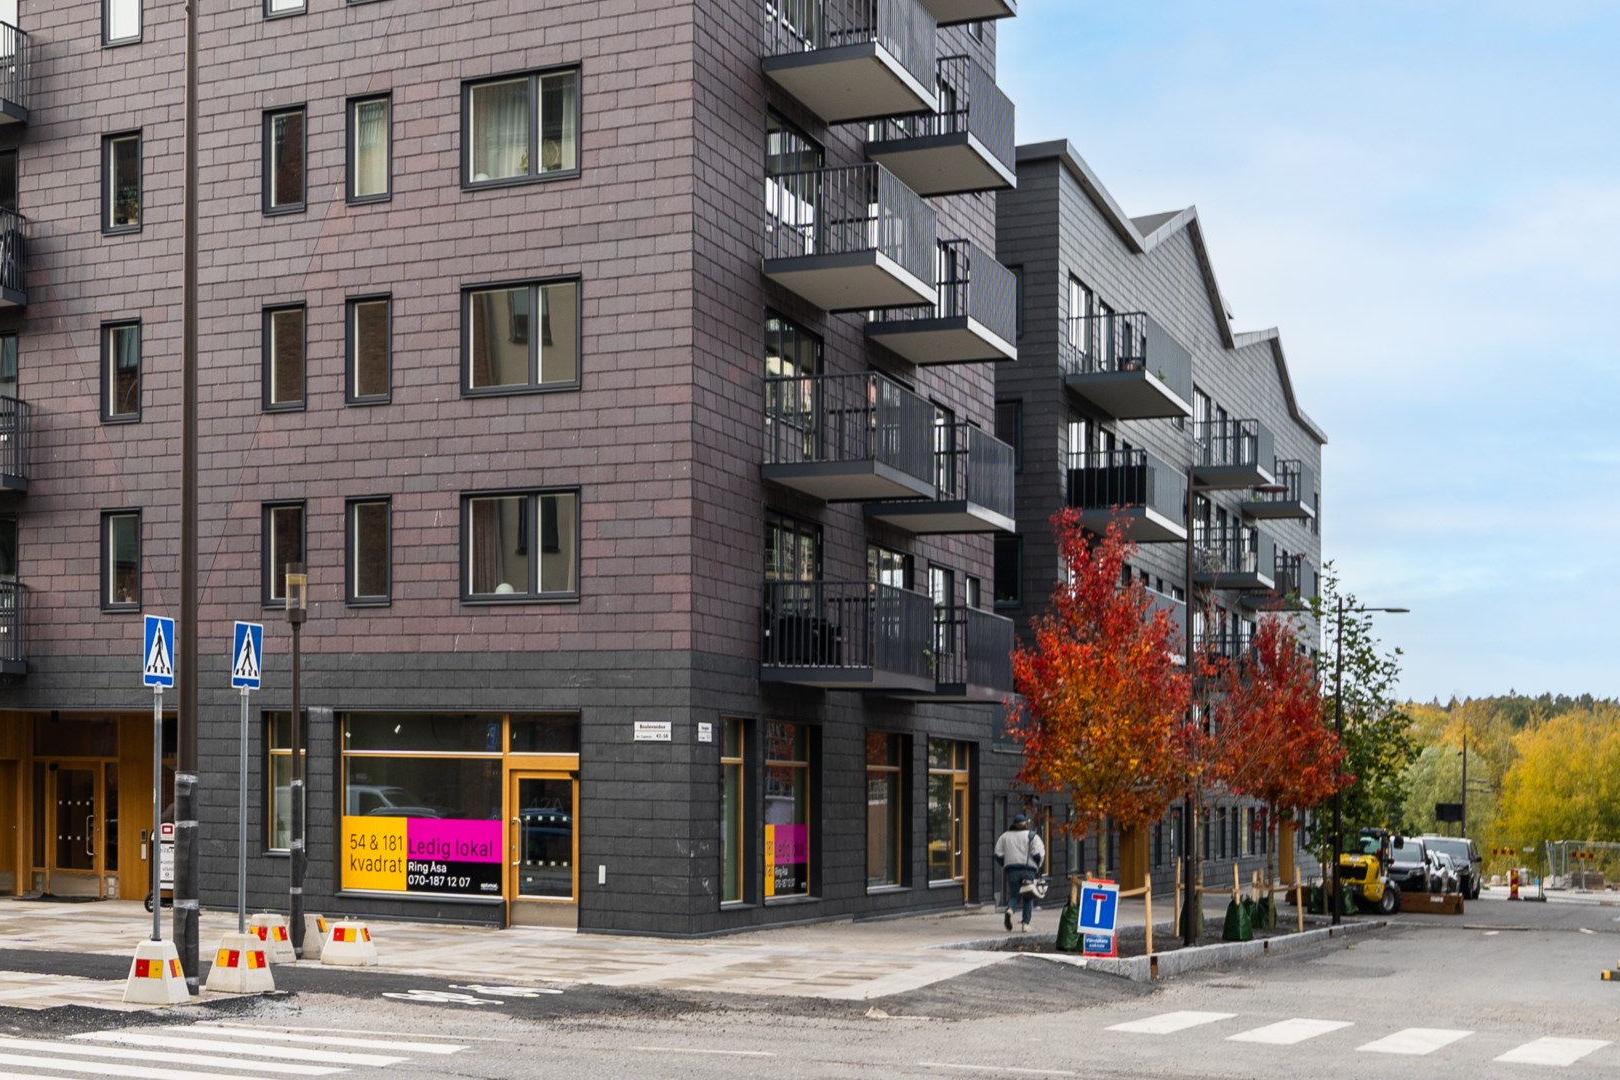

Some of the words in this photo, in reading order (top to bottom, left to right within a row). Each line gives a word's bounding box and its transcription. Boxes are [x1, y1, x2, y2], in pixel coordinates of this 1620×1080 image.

[350, 834, 366, 850] 54
[369, 835, 378, 851] &
[383, 835, 403, 851] 181
[408, 838, 451, 860] Ledig
[455, 840, 493, 857] lokal
[350, 854, 403, 873] kvadrat
[408, 861, 429, 875] Ring
[430, 861, 448, 873] Åsa
[408, 874, 445, 887] 070-187
[447, 876, 457, 887] 12
[458, 877, 471, 888] 07
